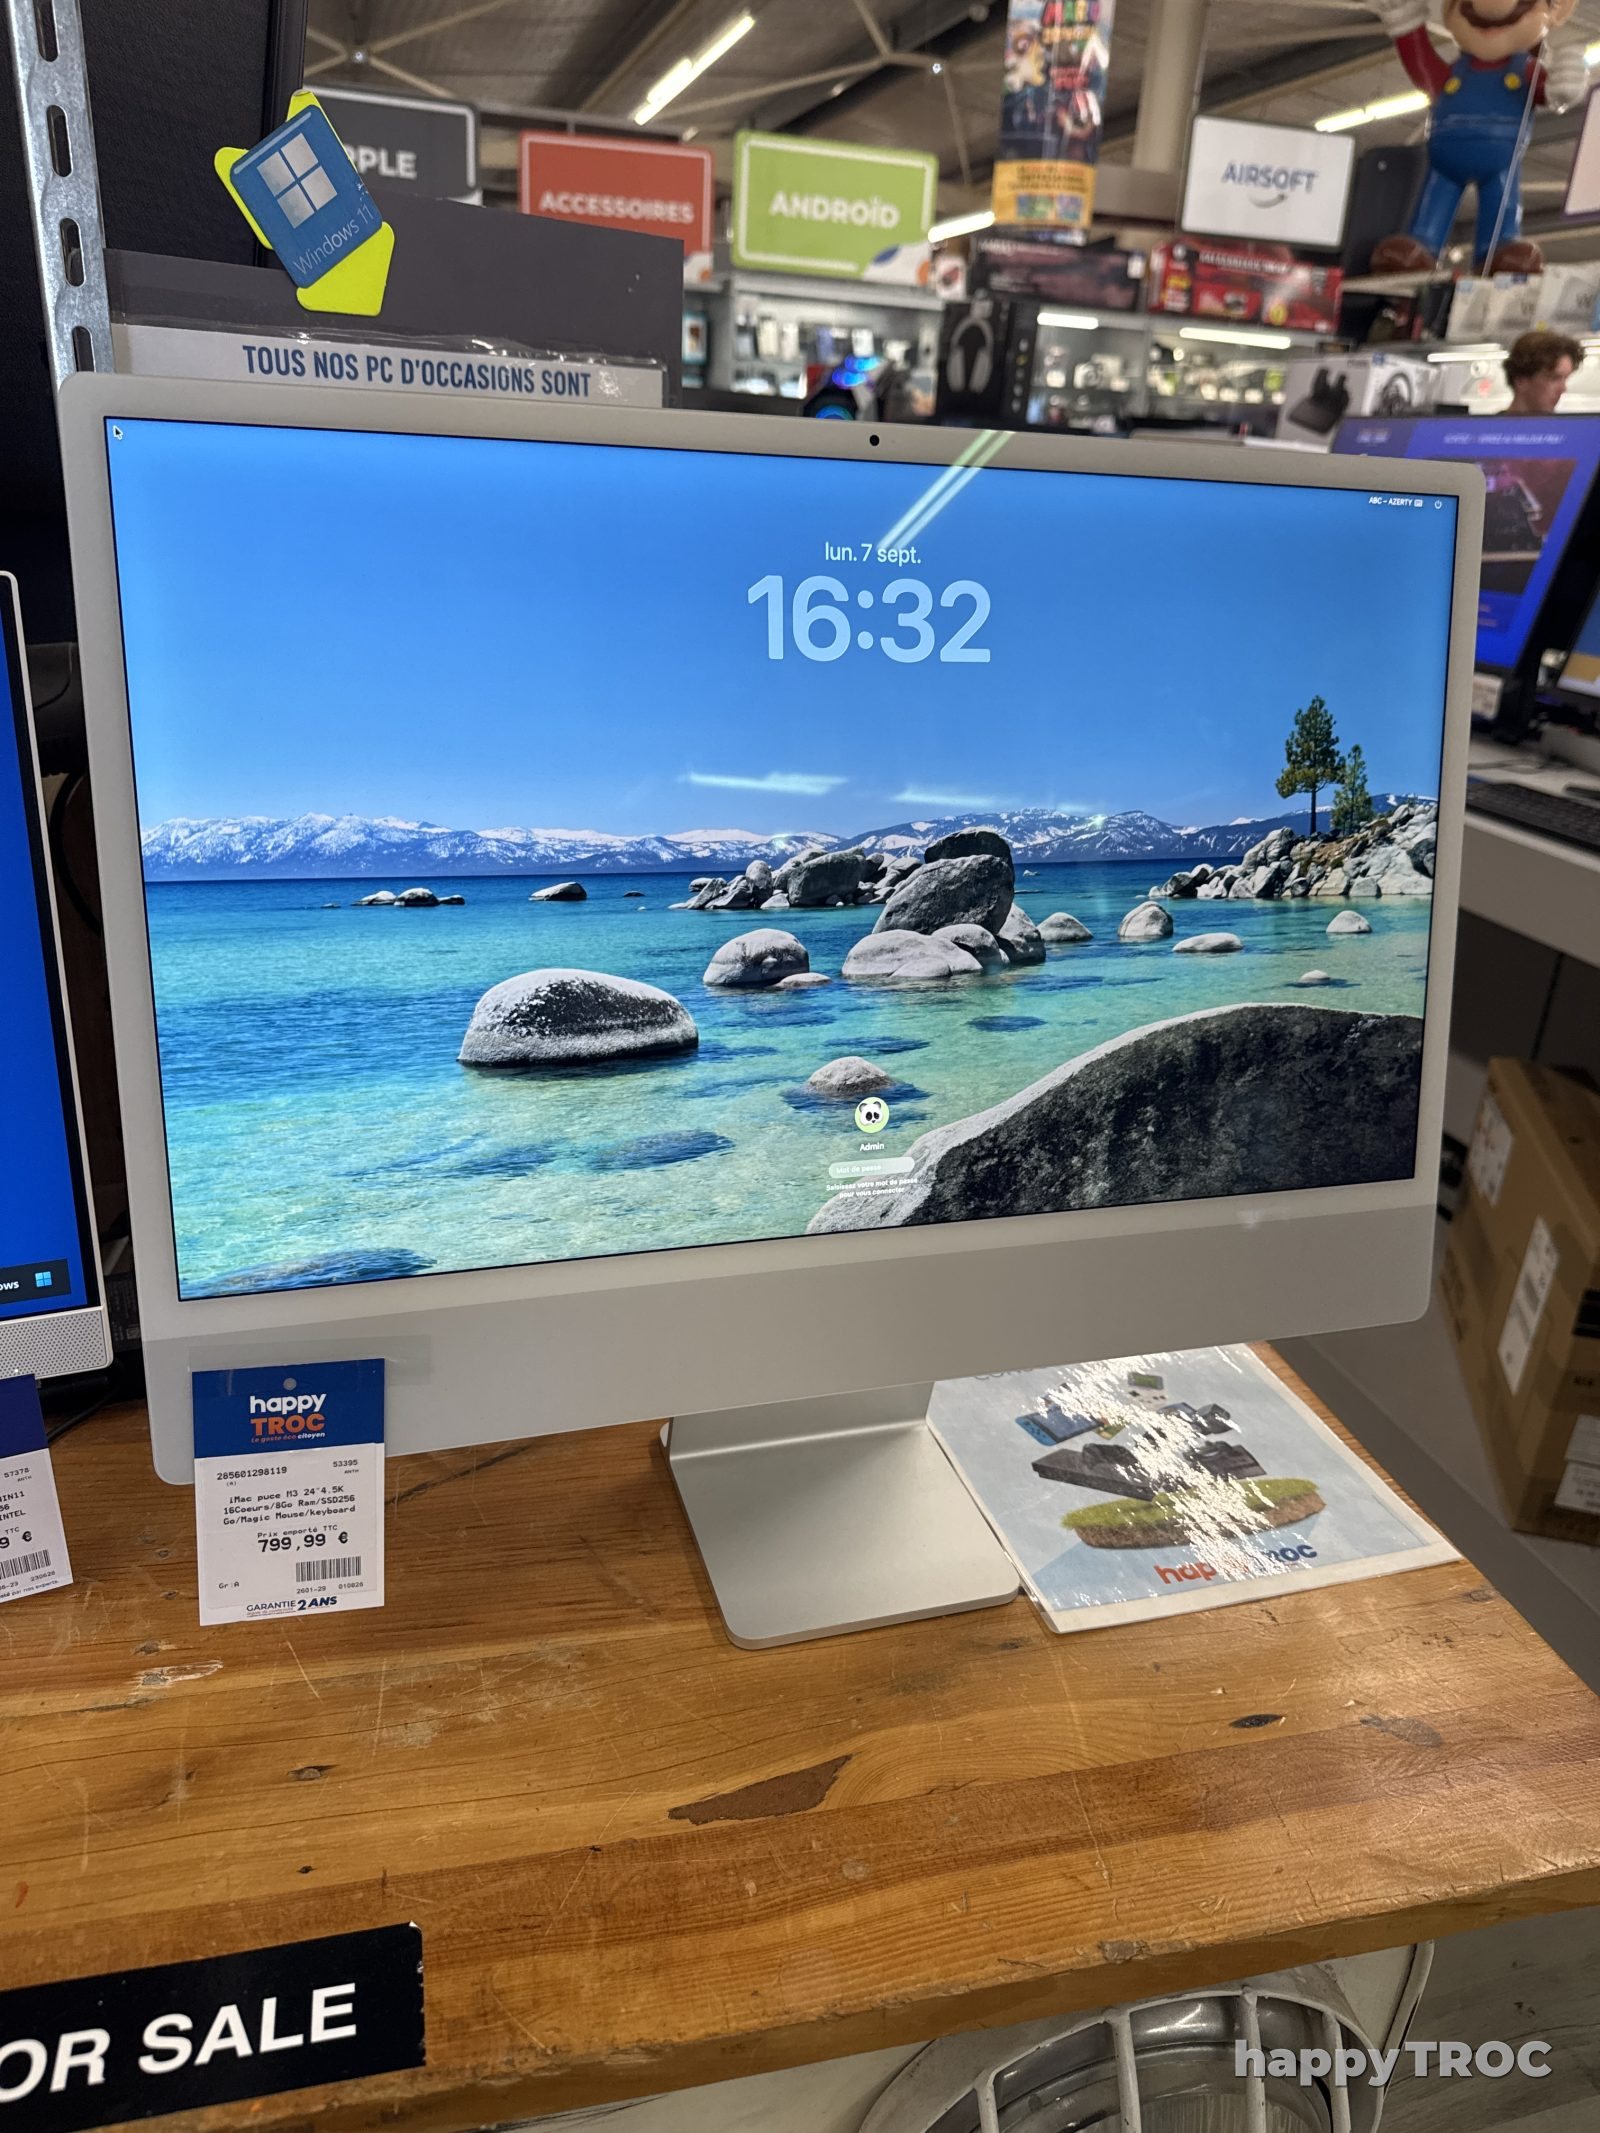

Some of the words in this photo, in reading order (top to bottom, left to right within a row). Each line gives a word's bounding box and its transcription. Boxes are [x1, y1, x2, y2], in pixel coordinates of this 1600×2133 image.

[346, 144, 417, 179] PLE
[1222, 162, 1318, 192] AIRSOFT
[538, 191, 694, 225] ACCESSOIRES
[769, 191, 900, 229] ANDROÏD
[293, 217, 360, 275] Windows
[357, 204, 374, 225] 11
[243, 345, 306, 377] TOUS
[313, 352, 359, 381] NOS
[366, 355, 393, 383] PC
[401, 358, 534, 394] D'OCCASIONS
[542, 370, 591, 397] SONT
[1368, 496, 1382, 505] ABC
[1388, 498, 1413, 507] AZERTY
[825, 541, 857, 562] lun.
[861, 543, 873, 561] 7
[877, 545, 921, 567] sept.
[748, 575, 991, 663] 16:32
[860, 1142, 884, 1151] Admin
[856, 1181, 874, 1189] votre
[876, 1179, 888, 1188] mot
[889, 1178, 898, 1186] de
[899, 1177, 918, 1187] passe
[839, 1191, 855, 1199] pour
[856, 1189, 872, 1197] vous
[872, 1187, 905, 1196] connecter
[0, 1281, 20, 1291] ows
[250, 1393, 326, 1415] happy
[250, 1413, 325, 1436] TROC
[297, 1432, 326, 1440] citoyen
[216, 1466, 288, 1480] 285601298119
[332, 1459, 358, 1468] 53395
[0, 1503, 10, 1511] 56
[223, 1501, 293, 1515] 16Coeurs/8Go
[298, 1494, 356, 1507] Ram/SSD256
[229, 1495, 252, 1504] iMac
[257, 1493, 281, 1502] puce
[223, 1514, 270, 1525] Go/Magic
[275, 1505, 356, 1520] Mouse/keyboard
[0, 1536, 10, 1549] 9
[22, 1530, 33, 1542] €
[5, 1526, 20, 1534] TTC
[283, 1527, 318, 1536] emporté
[323, 1524, 338, 1532] TTC
[257, 1533, 326, 1553] 799,99
[338, 1531, 349, 1544] €
[246, 1599, 297, 1612] GARANTIE
[297, 1599, 307, 1611] 2
[307, 1596, 338, 1608] ANS
[0, 2028, 110, 2104] OR
[138, 1982, 357, 2075] SALE
